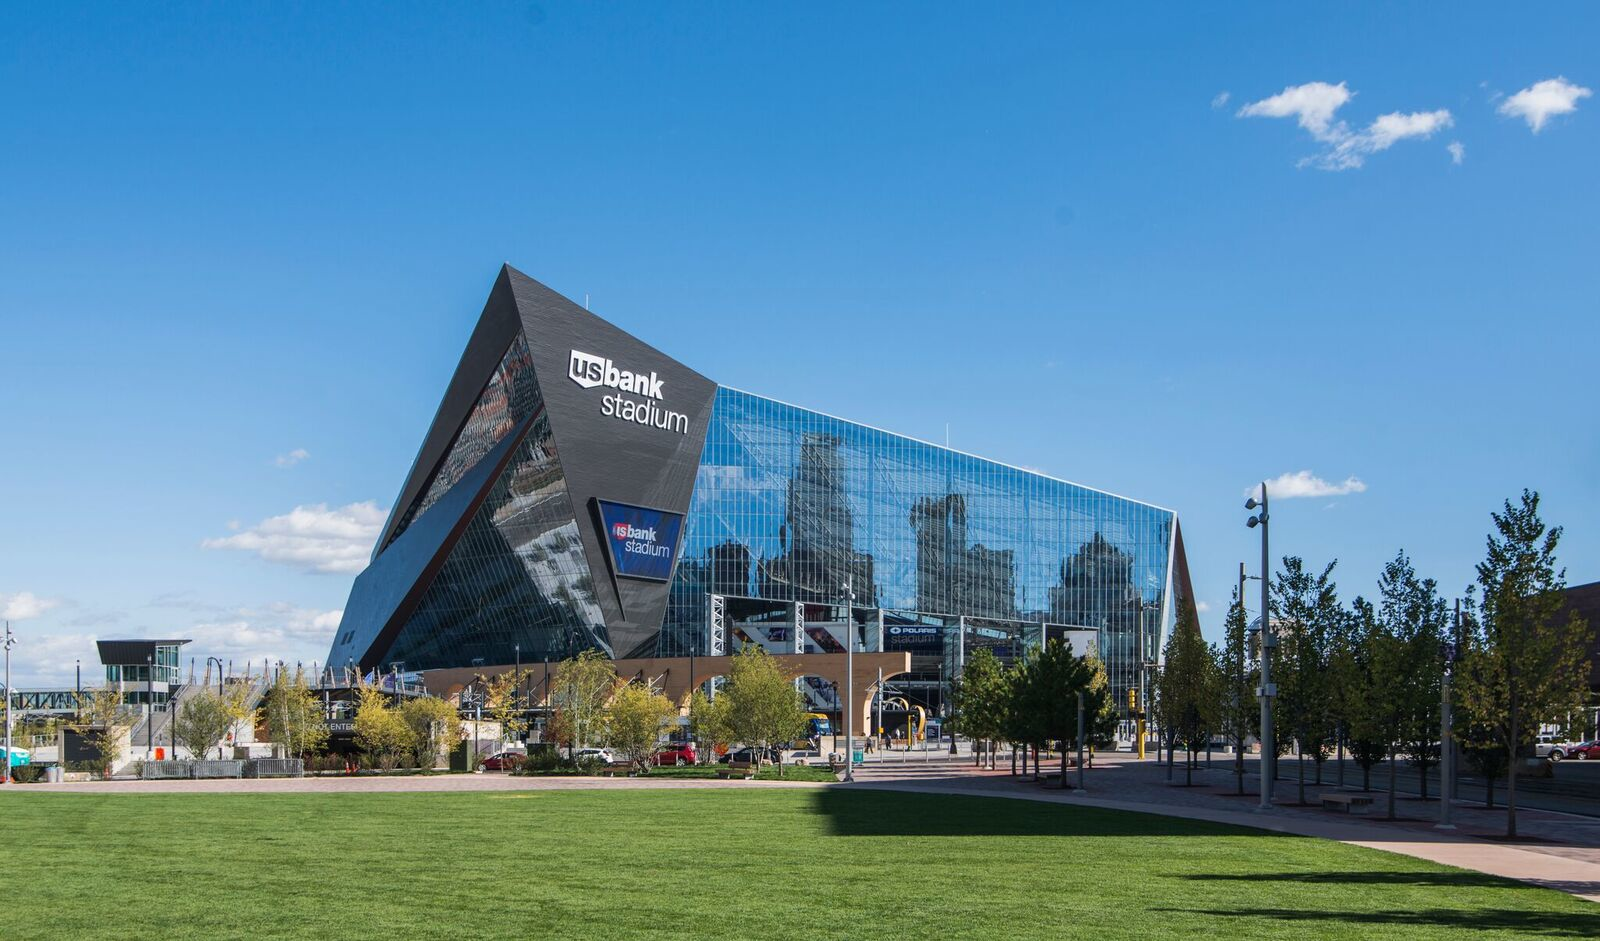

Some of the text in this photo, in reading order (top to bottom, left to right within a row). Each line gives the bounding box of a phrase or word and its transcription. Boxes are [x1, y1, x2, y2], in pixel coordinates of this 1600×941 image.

[601, 394, 689, 434] stadium
[625, 539, 670, 559] stadium
[890, 634, 935, 644] stadium
